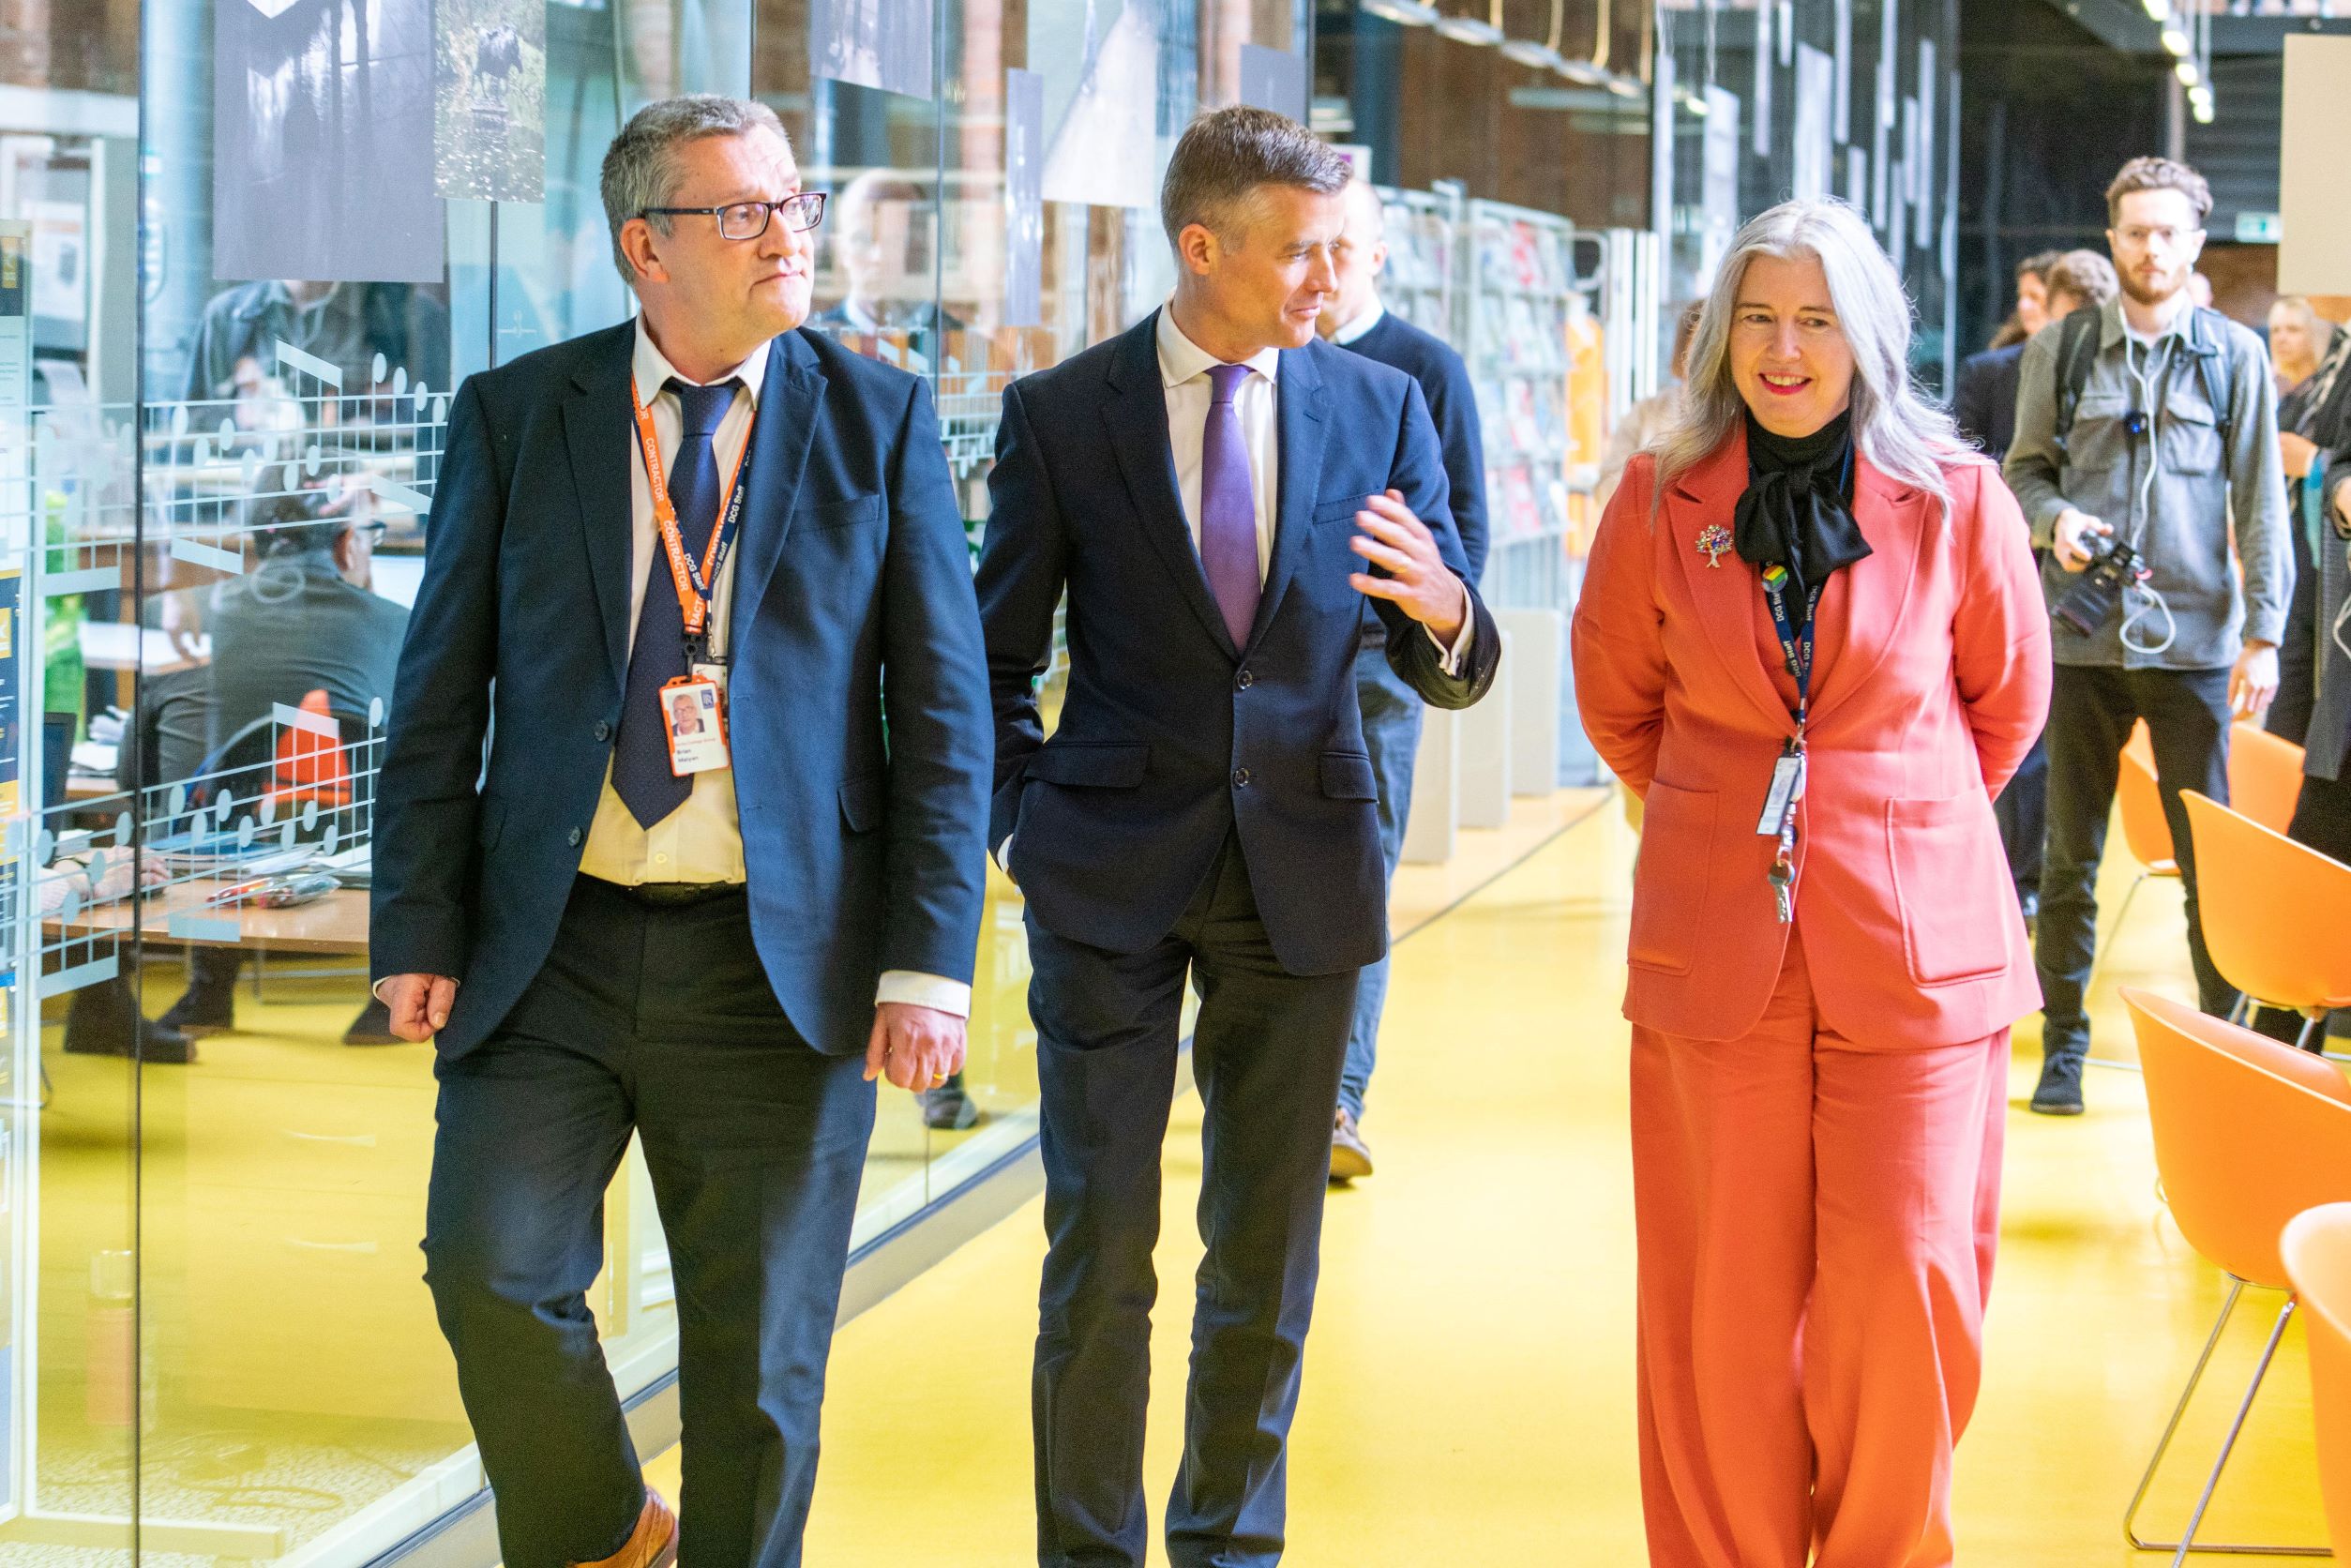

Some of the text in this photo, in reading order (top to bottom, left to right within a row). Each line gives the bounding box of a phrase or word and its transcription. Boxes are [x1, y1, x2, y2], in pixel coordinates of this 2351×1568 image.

[645, 437, 665, 503] CONTRACTOR
[728, 485, 746, 524] DCG Staff
[664, 520, 689, 592] CONTRACTOR
[684, 552, 698, 572] DCG
[717, 541, 728, 562] Staff
[1772, 592, 1785, 622] DCG Sta
[1783, 640, 1801, 677] DCG Staff
